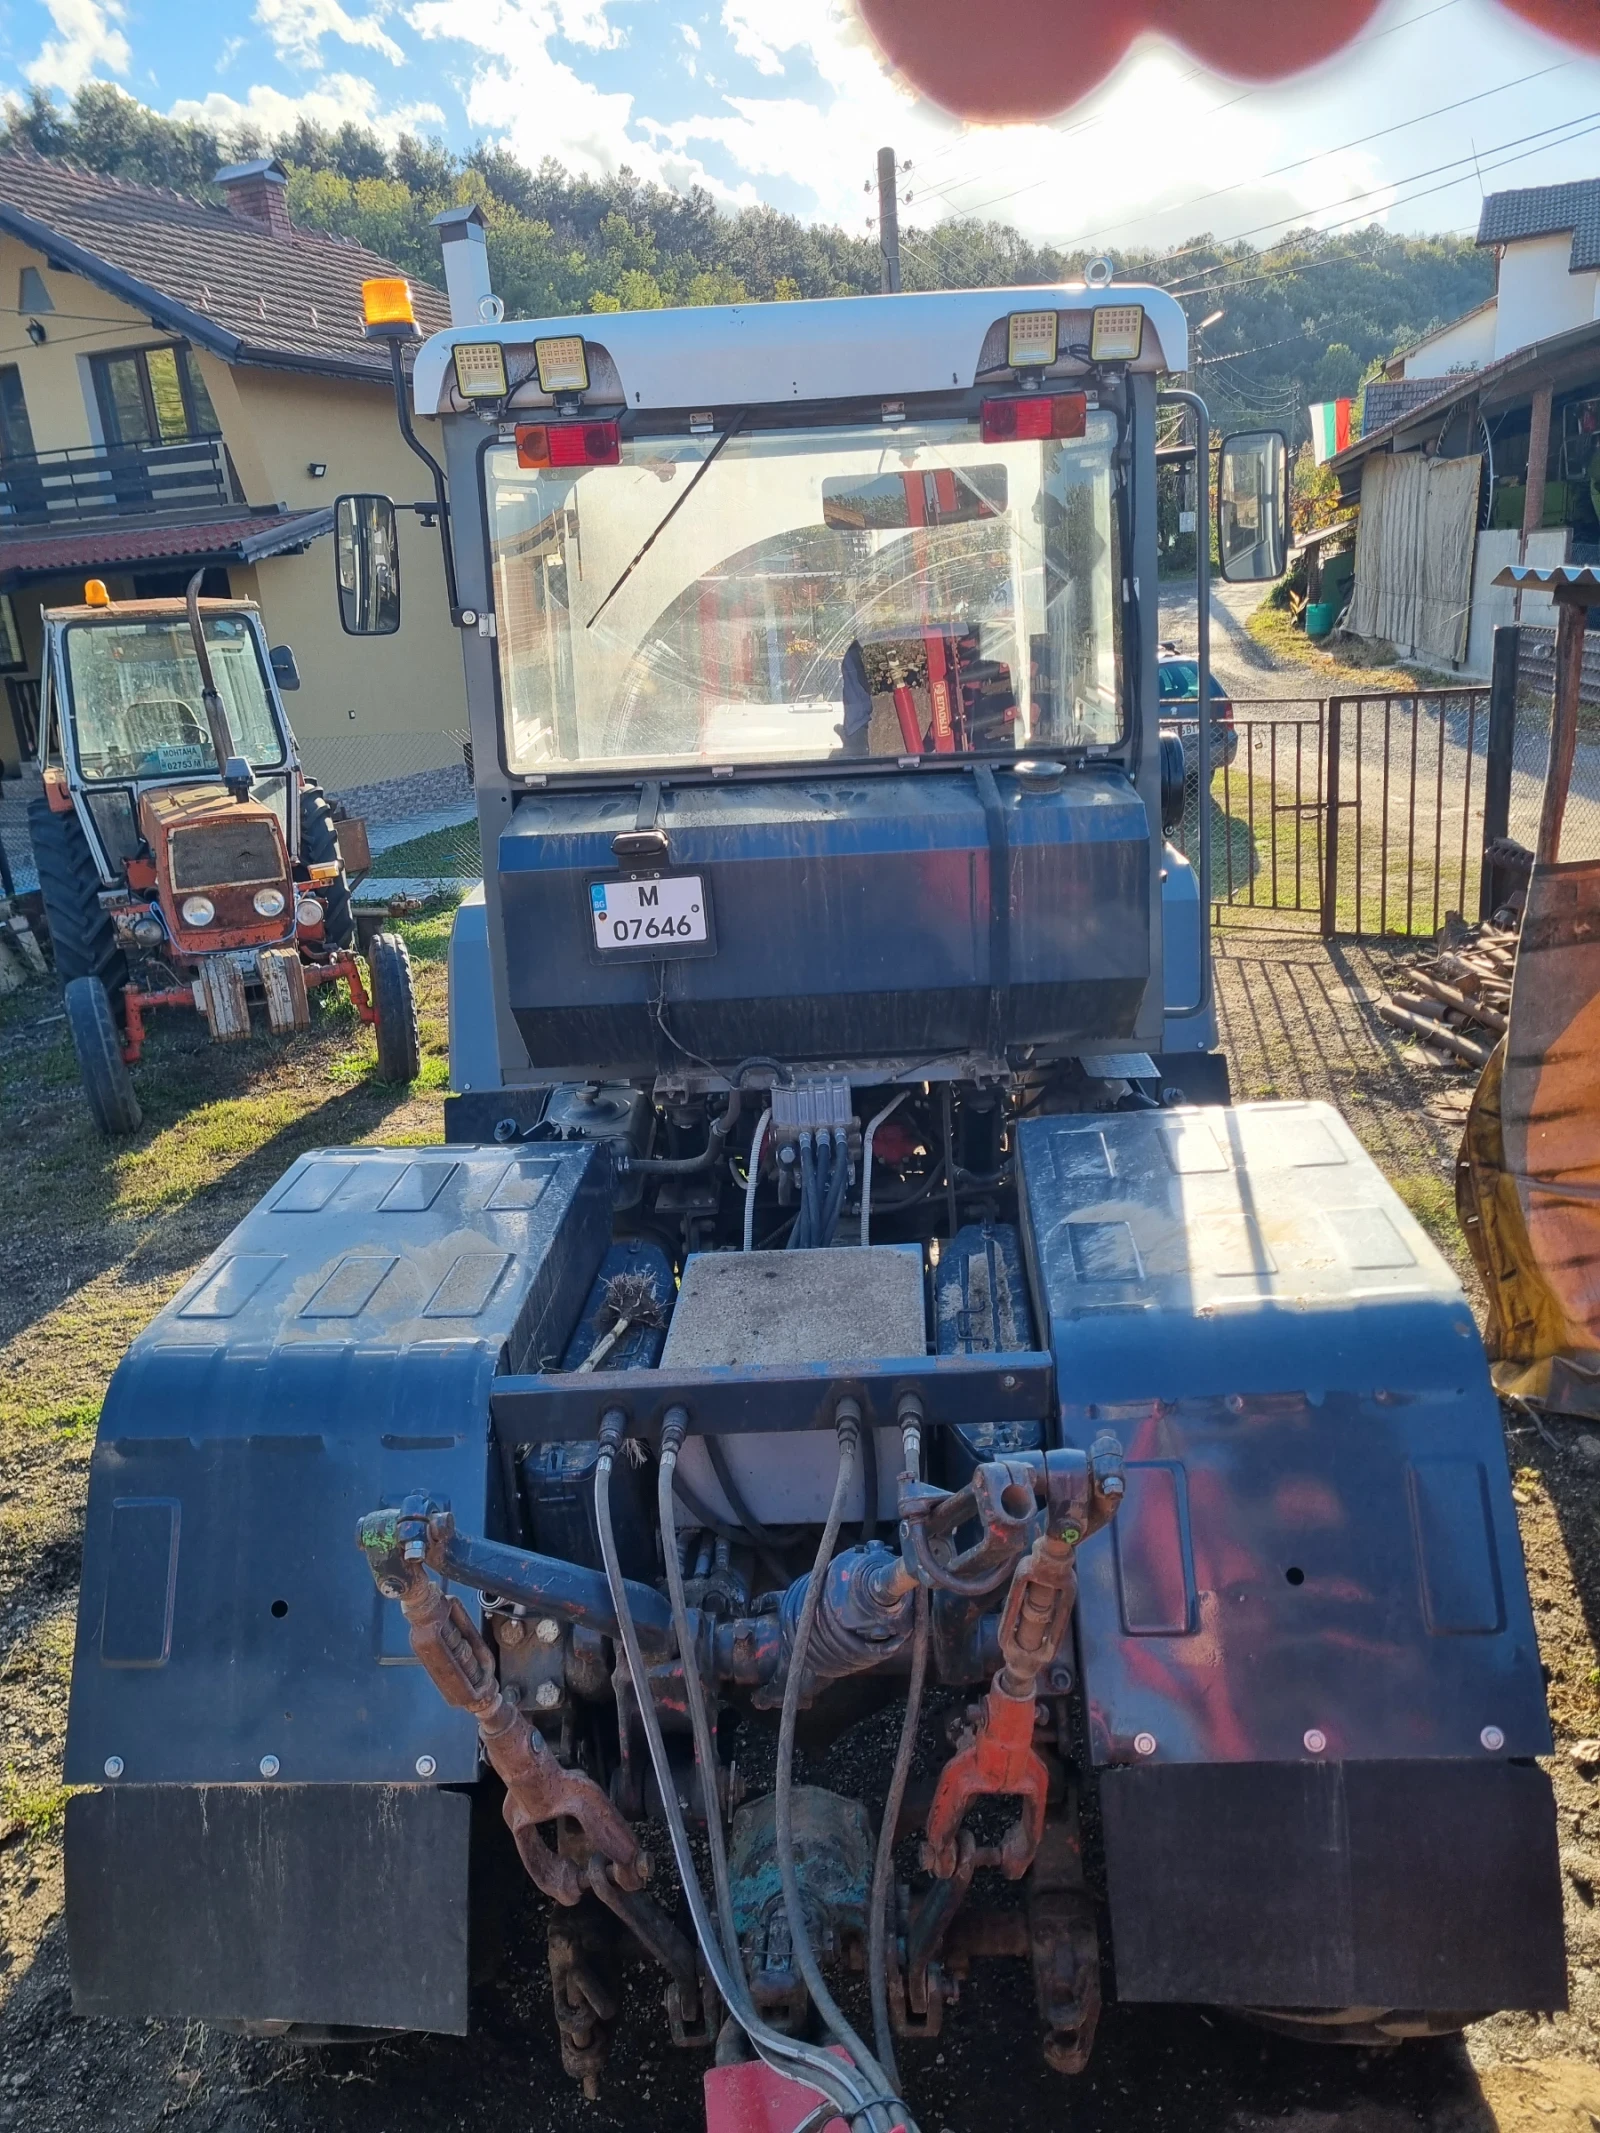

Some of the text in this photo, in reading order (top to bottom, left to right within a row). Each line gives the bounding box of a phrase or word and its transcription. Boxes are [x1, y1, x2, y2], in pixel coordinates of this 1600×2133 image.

[163, 747, 197, 757] МОНТАНА
[167, 760, 192, 770] 02753
[638, 885, 659, 907] M
[594, 901, 605, 909] BG
[613, 915, 692, 942] 07646
